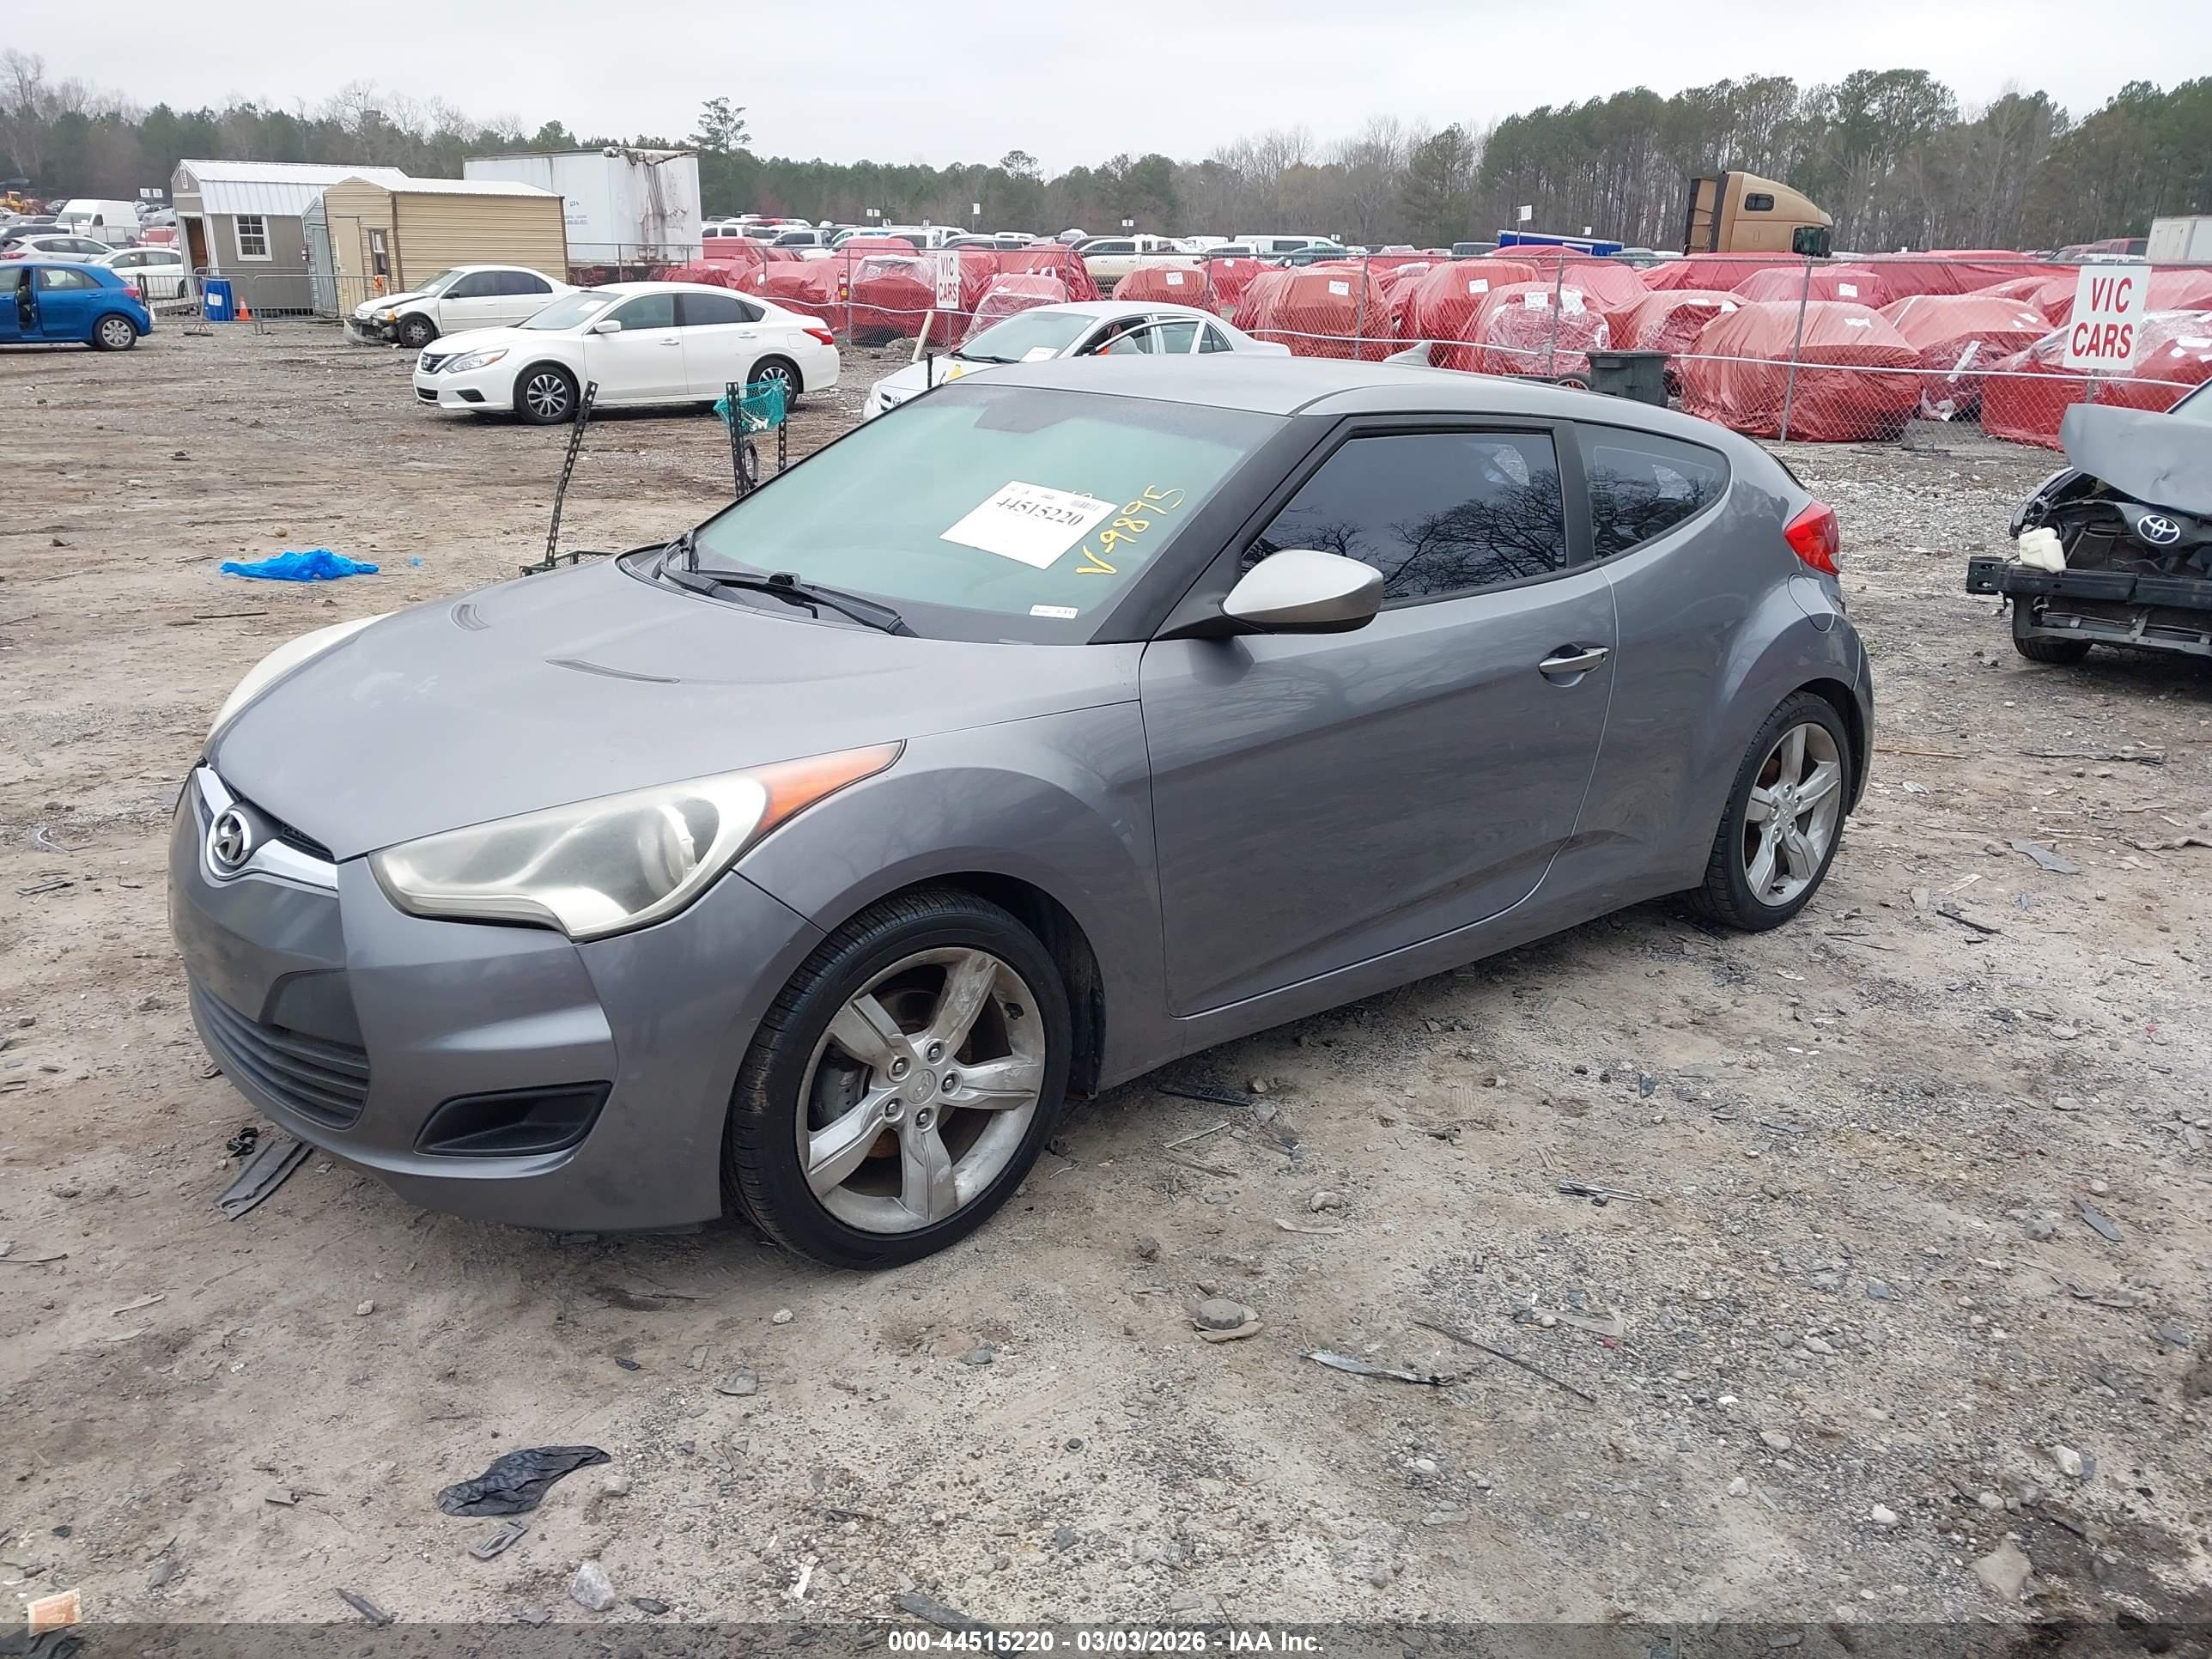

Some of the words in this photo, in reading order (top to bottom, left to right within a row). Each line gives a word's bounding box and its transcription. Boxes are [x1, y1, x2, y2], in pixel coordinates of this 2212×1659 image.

[941, 257, 954, 276] VIC
[938, 282, 957, 302] CARS
[2092, 277, 2132, 313] VIC
[2072, 322, 2133, 358] CARS
[996, 498, 1084, 526] 44515220
